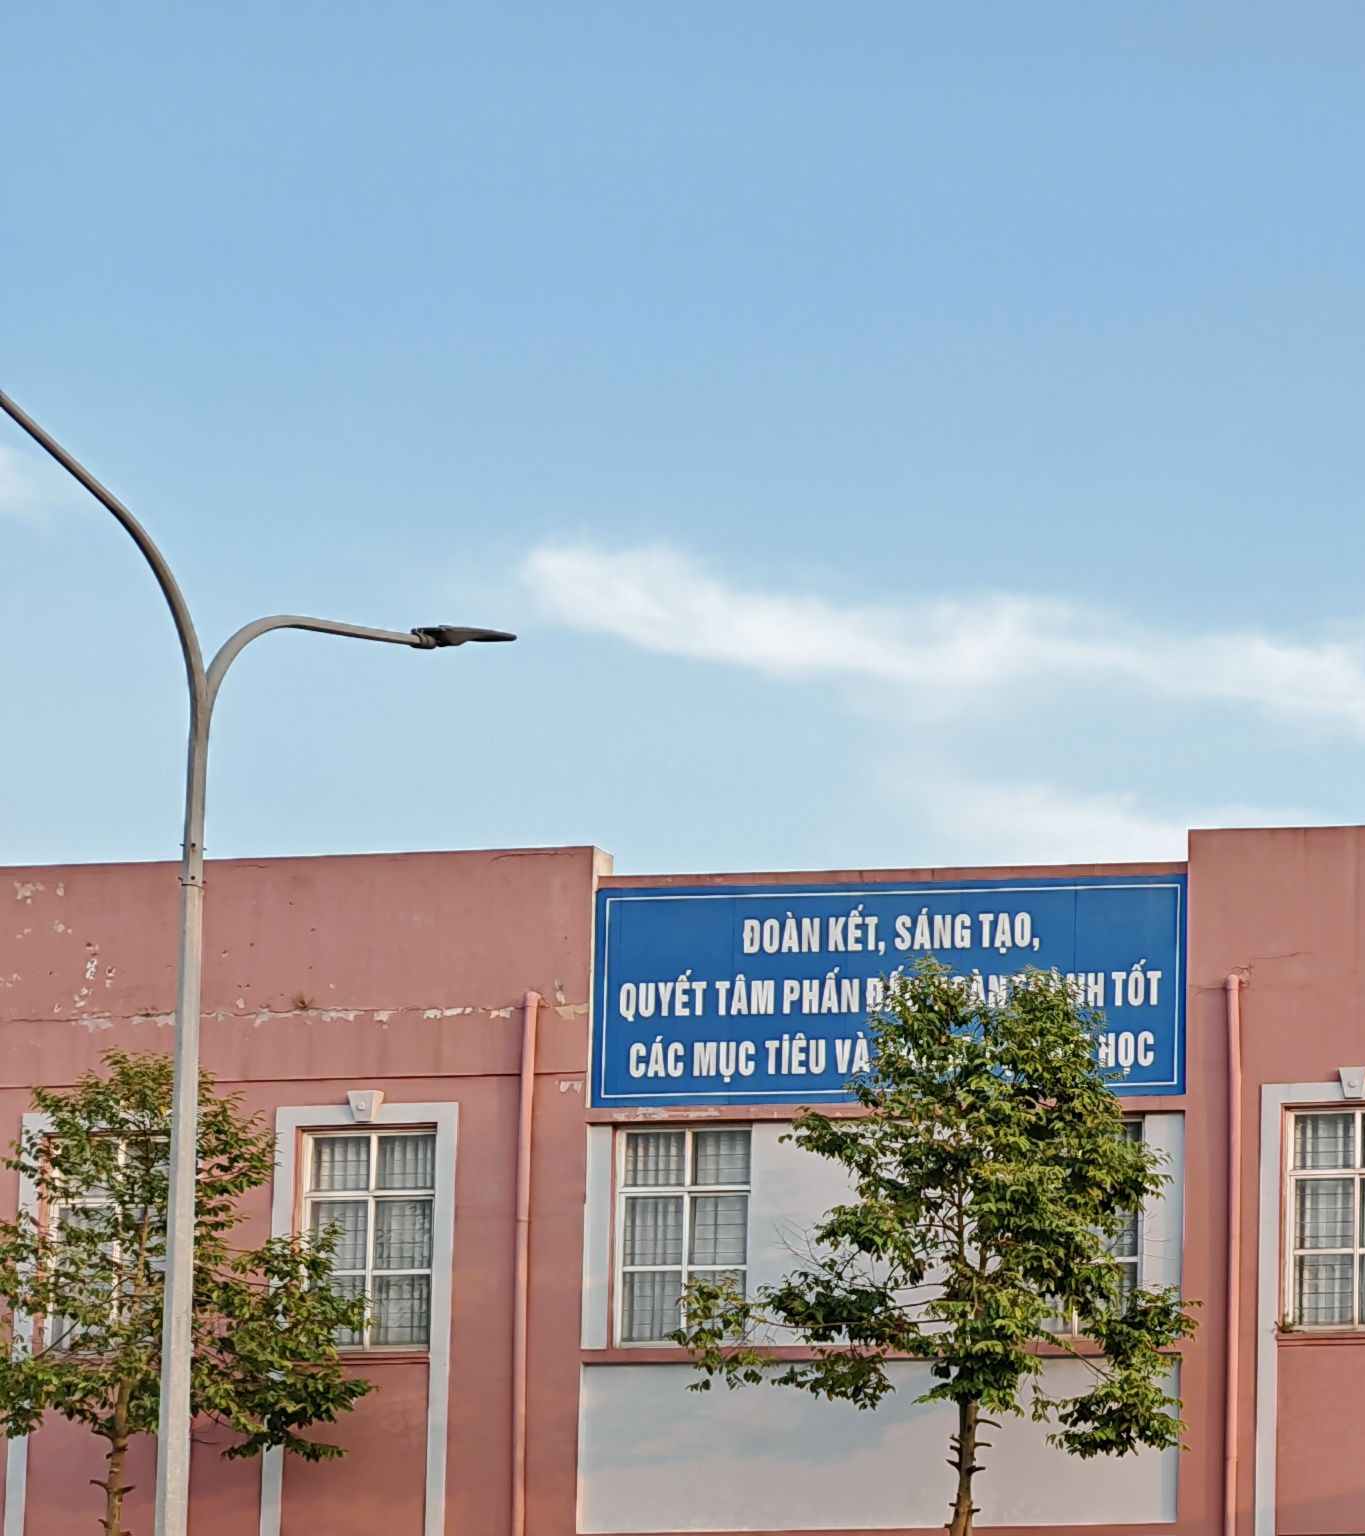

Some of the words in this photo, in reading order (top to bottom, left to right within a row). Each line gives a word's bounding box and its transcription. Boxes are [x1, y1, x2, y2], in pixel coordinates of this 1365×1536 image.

[742, 911, 820, 954] ĐOÀN
[828, 904, 885, 955] KẾT,
[894, 907, 971, 951] SÁNG
[979, 911, 1040, 954] TẠO,
[619, 969, 707, 1022] QUYẾT
[715, 974, 775, 1016] TÂM
[782, 967, 860, 1014] PHẤN
[1111, 959, 1162, 1007] TỐT
[629, 1035, 684, 1078] CÁC
[693, 1040, 756, 1083] MỤC
[835, 1031, 872, 1074] VÀ
